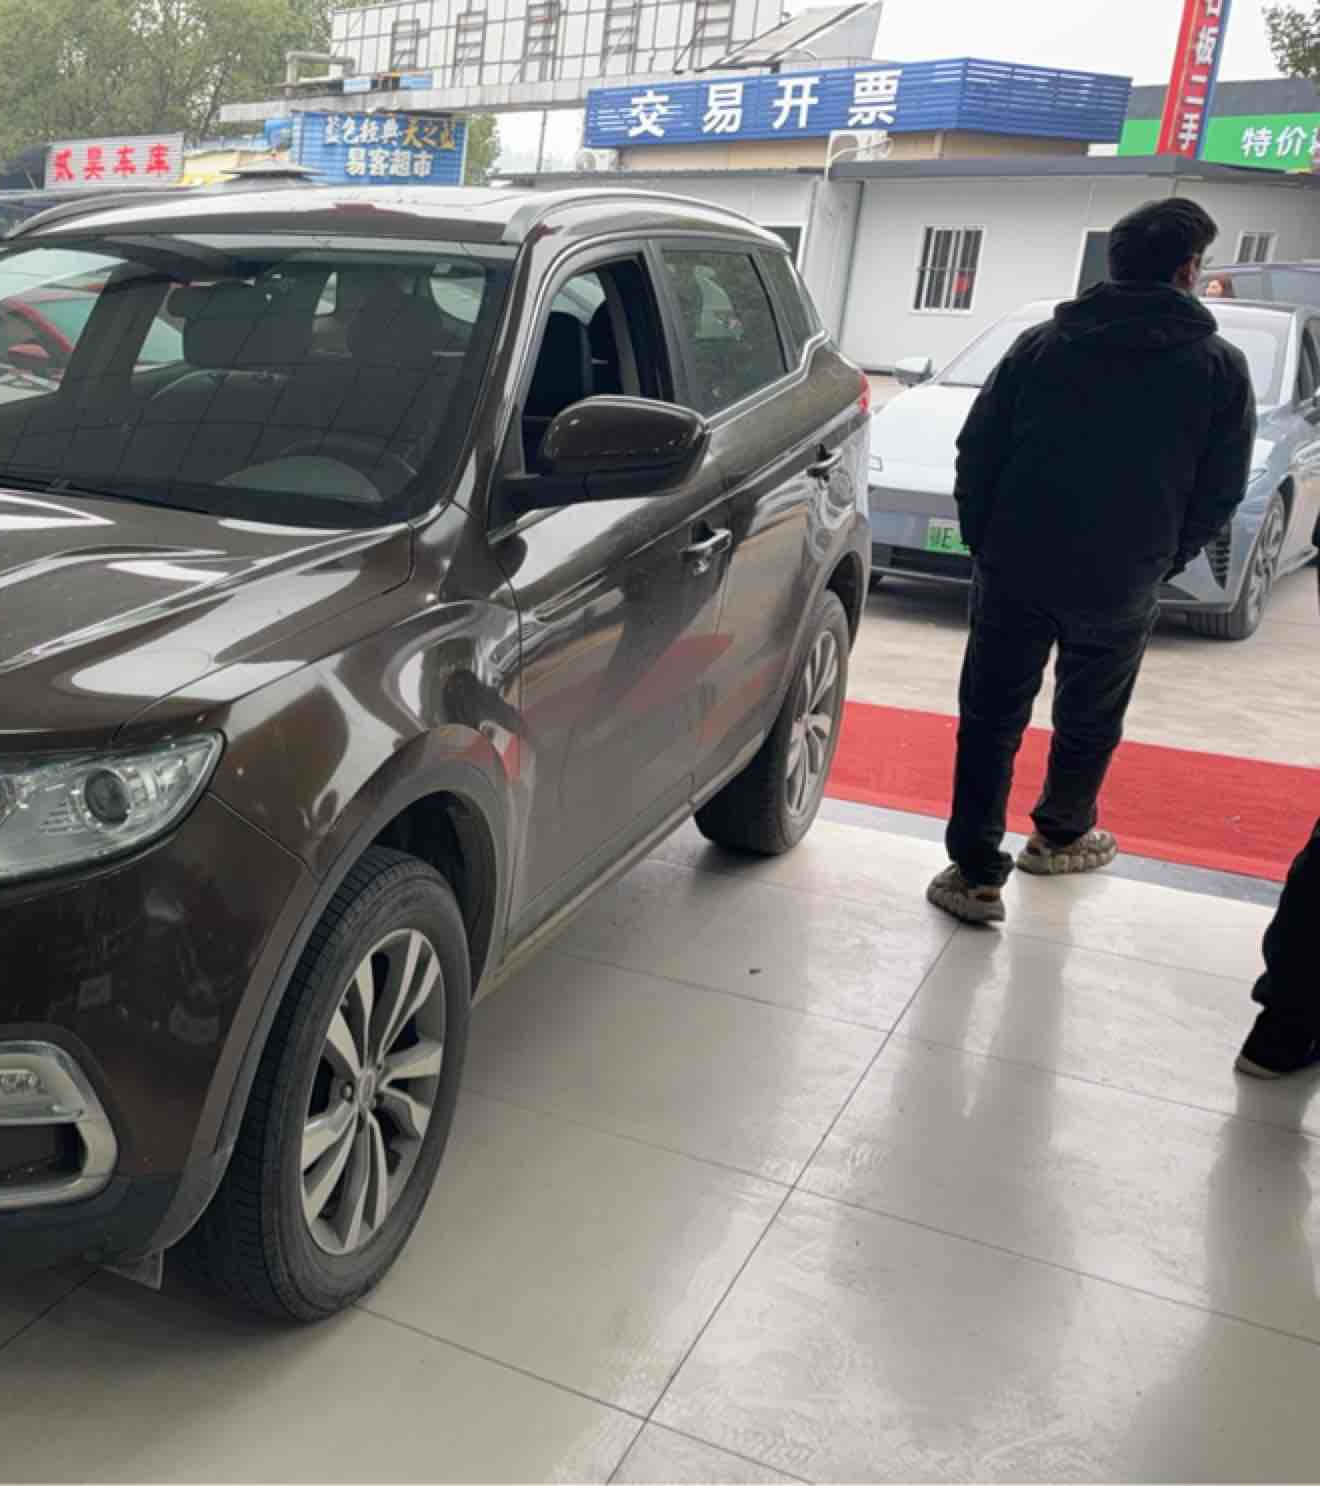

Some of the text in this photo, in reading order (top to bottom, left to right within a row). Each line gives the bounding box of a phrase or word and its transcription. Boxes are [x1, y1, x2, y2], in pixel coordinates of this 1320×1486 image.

[626, 67, 905, 138] 交易开票
[344, 146, 434, 177] 易客超市
